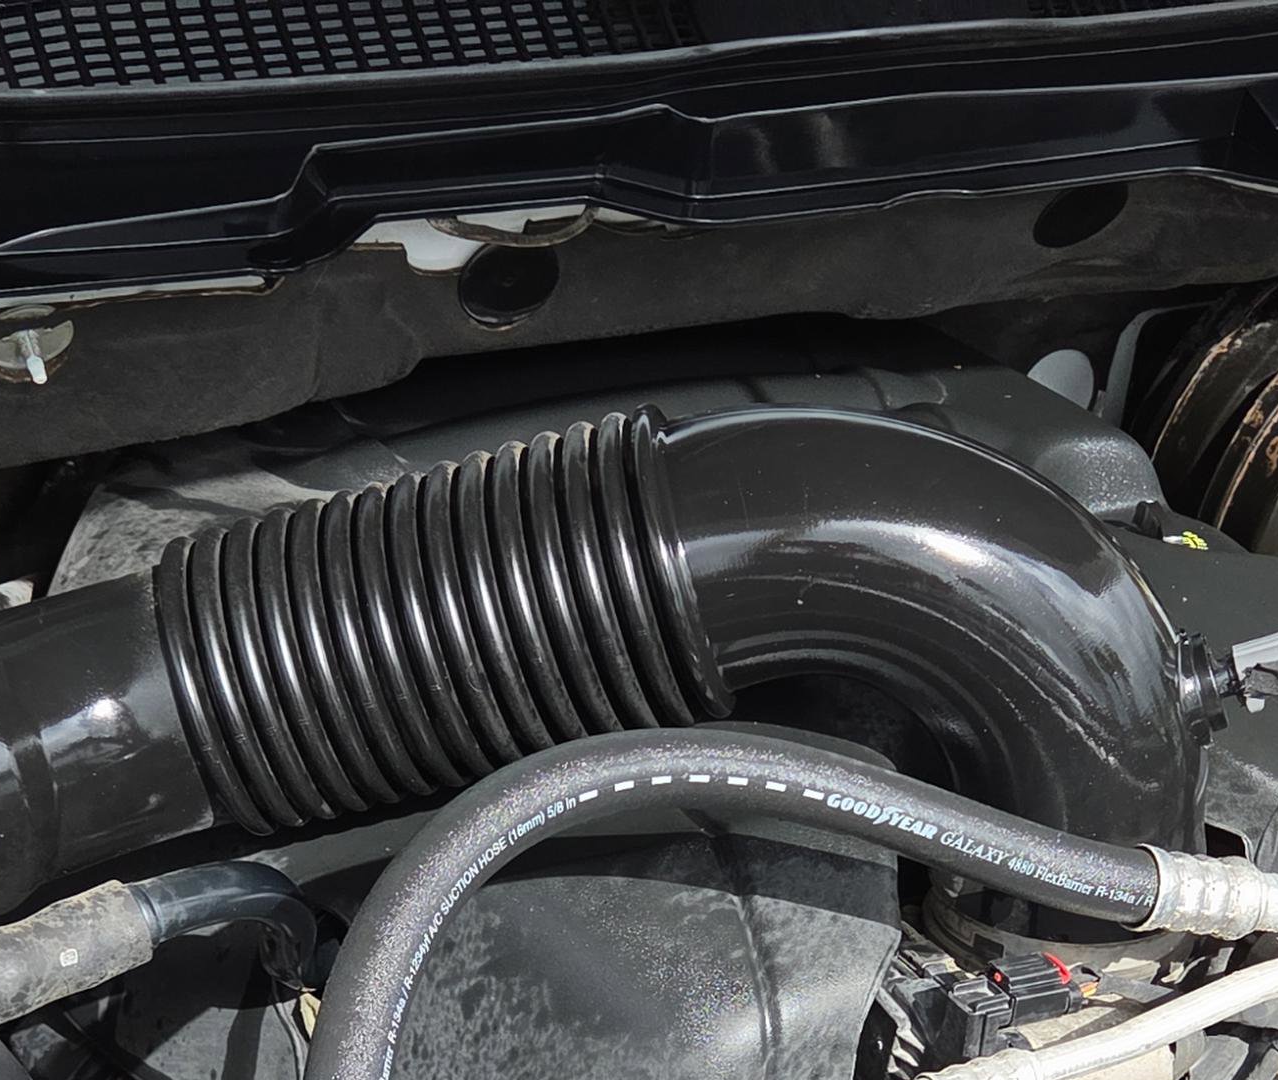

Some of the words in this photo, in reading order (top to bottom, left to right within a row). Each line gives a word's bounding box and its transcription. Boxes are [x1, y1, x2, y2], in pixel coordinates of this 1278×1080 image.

[428, 912, 443, 939] A/C
[440, 862, 479, 915] SUCTION
[478, 836, 507, 869] HOSE
[508, 811, 545, 845] (16mm)
[547, 801, 564, 818] 5/8
[826, 793, 938, 840] GOODYEAR
[940, 831, 1009, 865] GALAXY
[1008, 856, 1035, 876] 4880
[1033, 865, 1094, 896] FlexBarrier
[1094, 885, 1135, 905] R-134a
